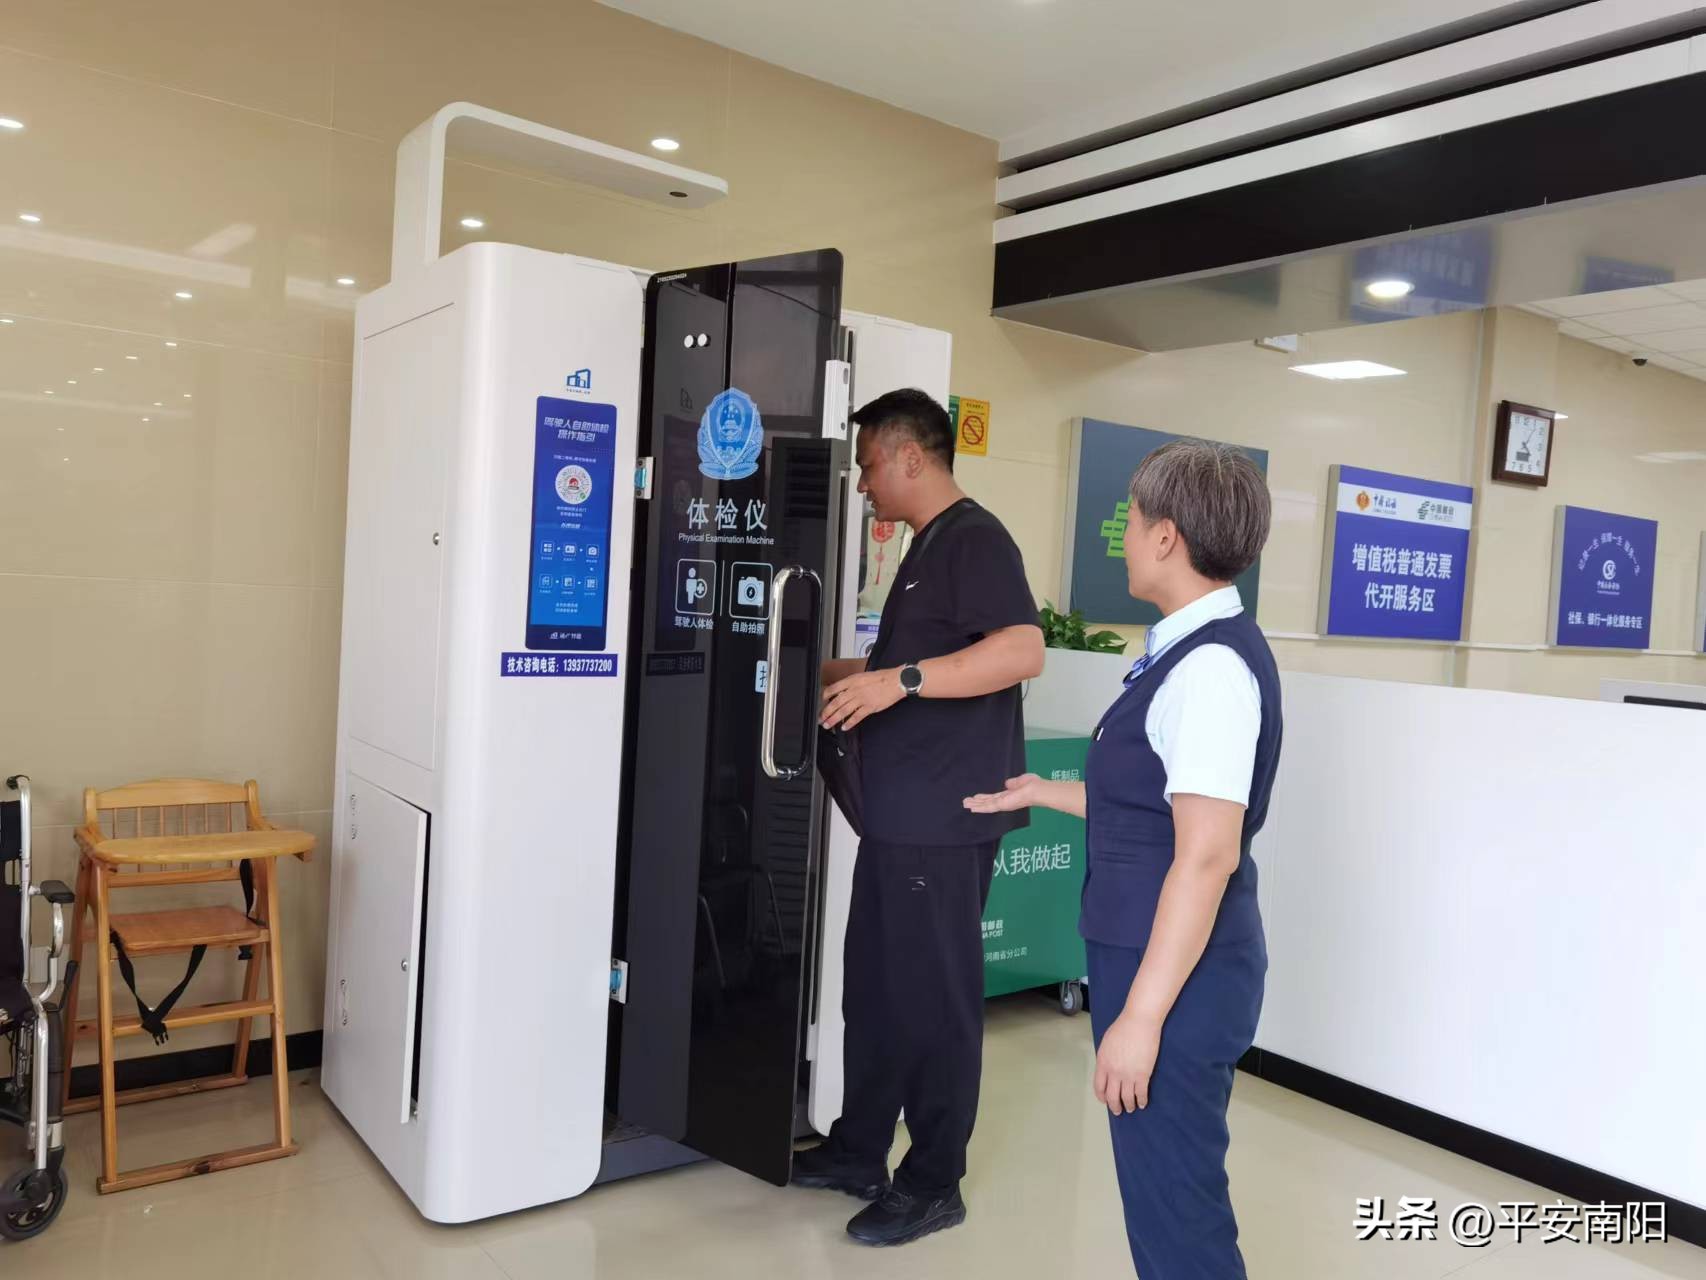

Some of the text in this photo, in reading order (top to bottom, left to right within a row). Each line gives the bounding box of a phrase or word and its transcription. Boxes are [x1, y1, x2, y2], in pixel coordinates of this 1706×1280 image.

[687, 498, 768, 531] 体检仪
[679, 533, 774, 545] Physical Examination Machine
[1352, 544, 1453, 579] 增值税普通发票
[1365, 582, 1436, 612] 代开服务区
[674, 616, 714, 630] 驾驶人体检
[731, 621, 765, 634] 自助拍照
